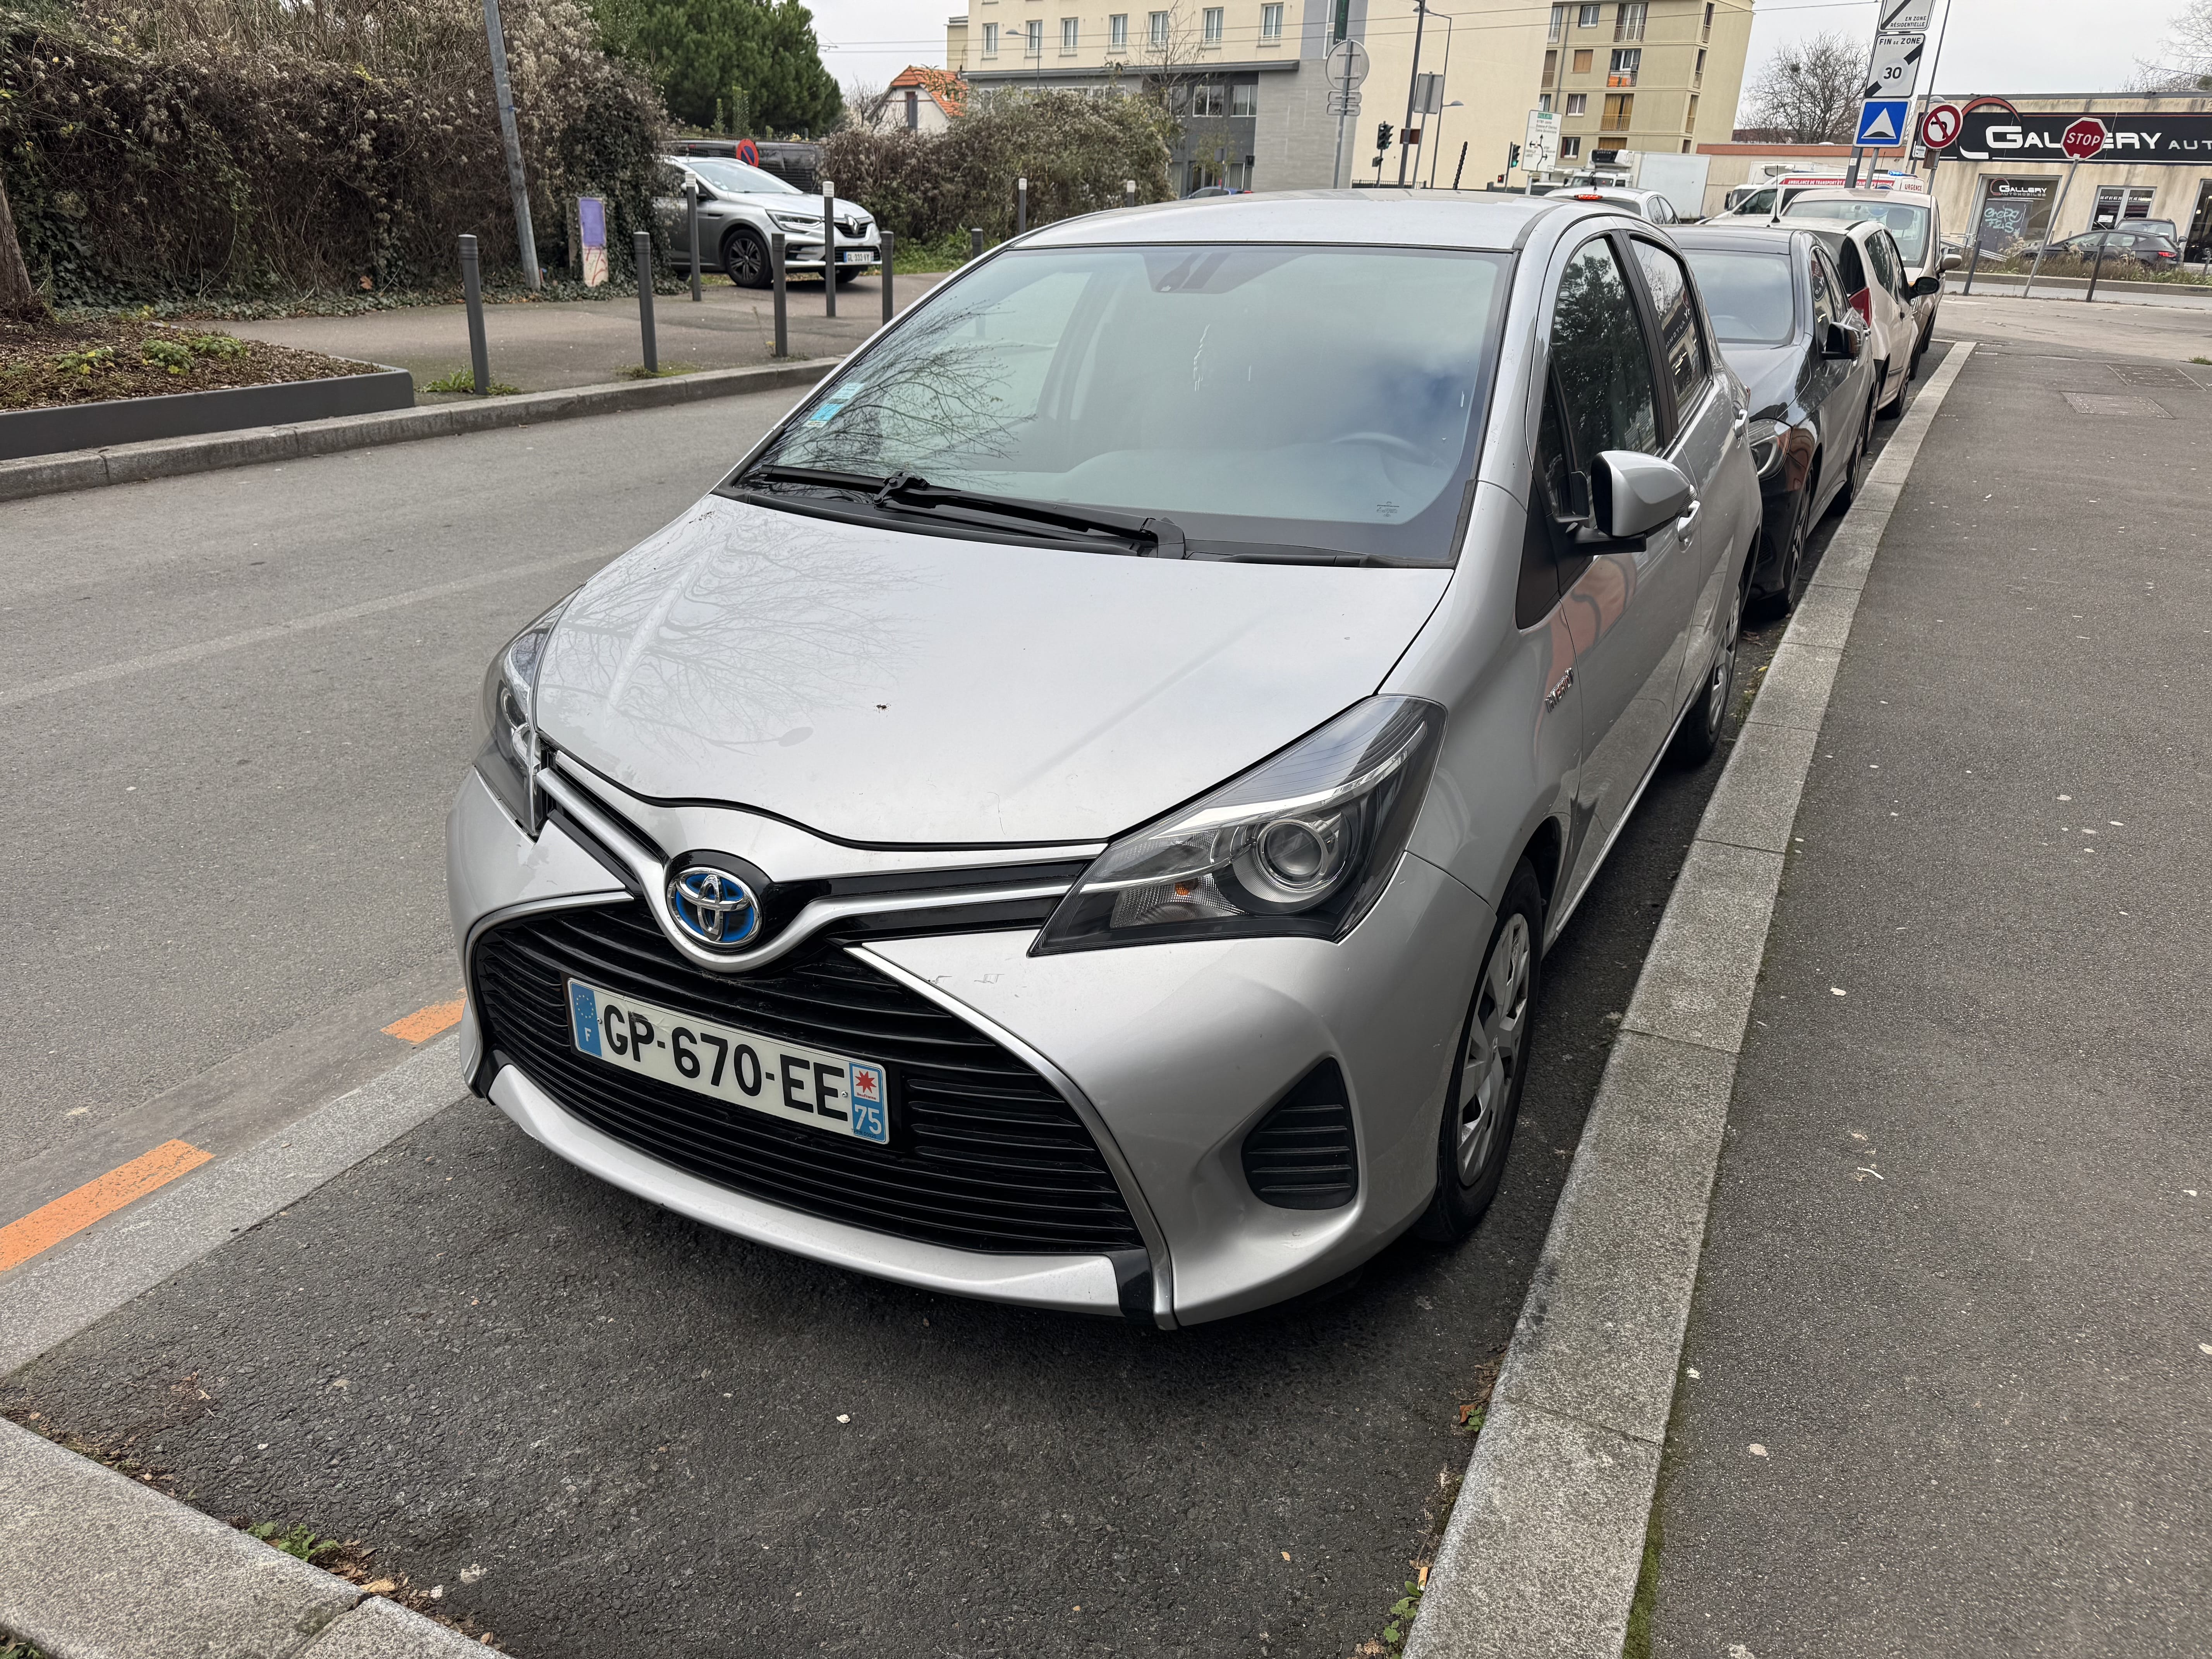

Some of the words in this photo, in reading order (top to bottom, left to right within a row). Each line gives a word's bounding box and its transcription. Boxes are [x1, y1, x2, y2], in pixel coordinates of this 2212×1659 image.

[1883, 67, 1902, 79] 30
[2066, 132, 2101, 146] STOP
[1999, 185, 2047, 193] GALLERY
[584, 1027, 592, 1042] F
[604, 1003, 848, 1122] GP-670-EE
[855, 1104, 882, 1135] 75
